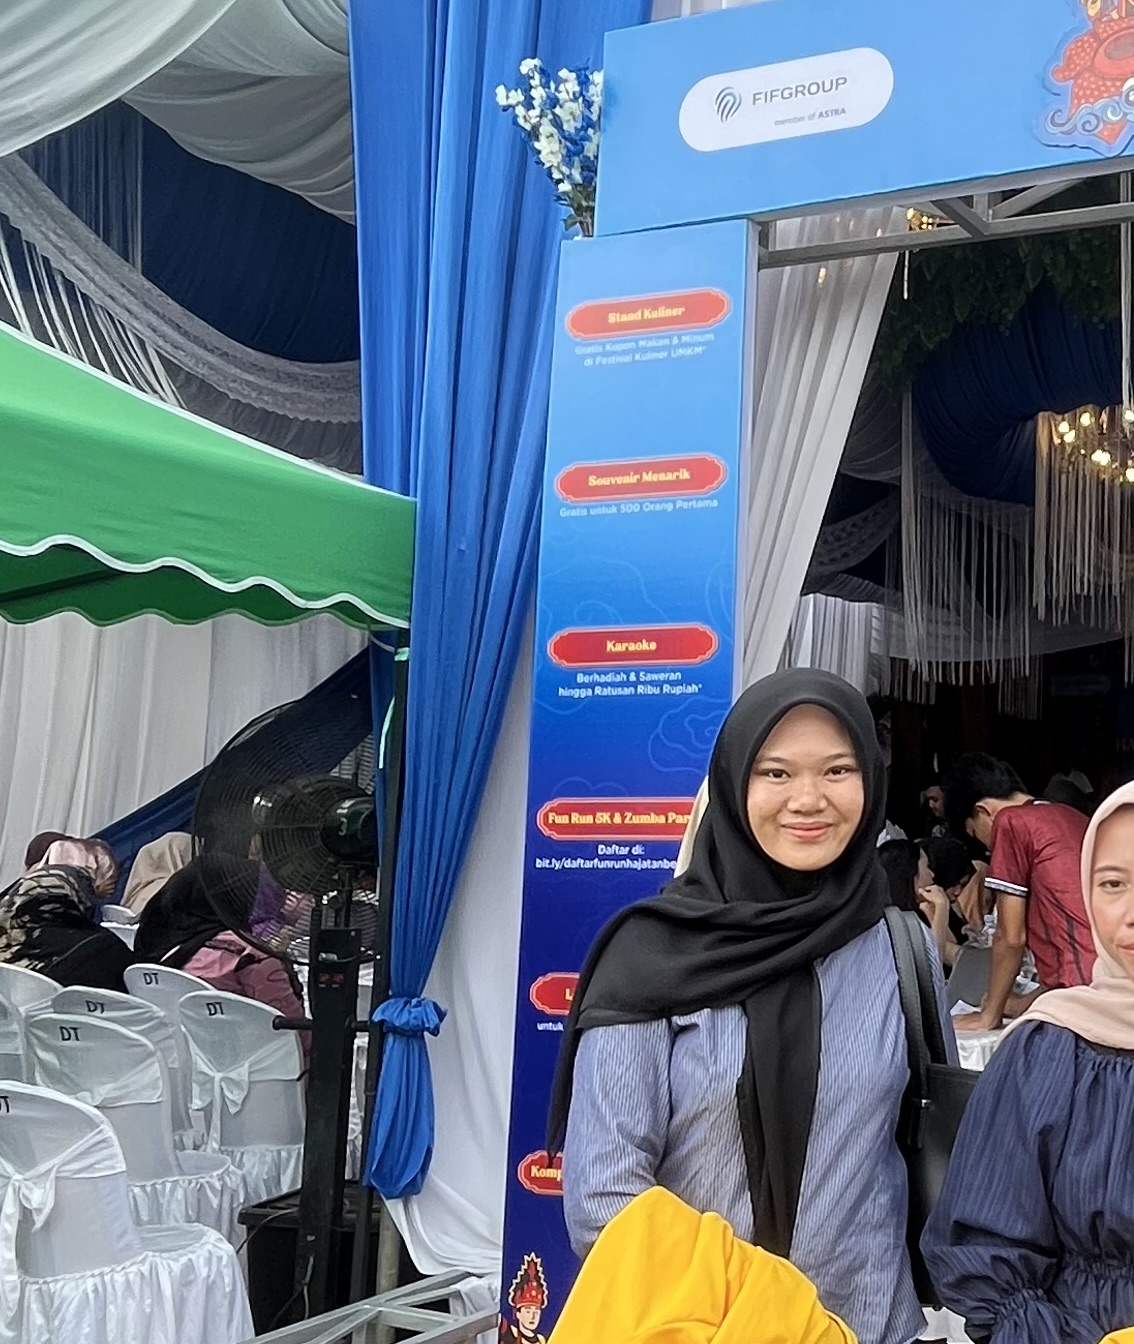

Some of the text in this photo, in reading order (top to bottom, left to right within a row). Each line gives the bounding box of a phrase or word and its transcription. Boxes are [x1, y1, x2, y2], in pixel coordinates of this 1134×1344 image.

[752, 76, 848, 106] FIFGROUP
[818, 107, 846, 120] ASTRA
[608, 306, 686, 324] Stand Kuliner
[575, 343, 603, 355] Gratis
[605, 341, 636, 353] Kupon
[638, 338, 670, 349] Makan
[682, 333, 714, 344] Minum
[583, 356, 594, 367] di
[595, 354, 633, 365] Festival
[635, 351, 668, 362] Kuliner
[588, 468, 690, 487] Souvenir Menarik
[559, 498, 718, 518] Gratis untuk 500 Orang Pertama
[606, 638, 657, 653] Karaoke
[576, 671, 681, 684] Berhadiah & Saweran
[558, 687, 593, 699] hingga
[594, 685, 635, 697] Ratusan
[637, 684, 660, 695] Ribu
[548, 812, 569, 824] Fun
[571, 811, 593, 824] Run
[595, 811, 611, 824] 5K
[613, 812, 622, 824] &
[624, 811, 666, 824] Zumba
[598, 844, 630, 855] Daftar
[143, 972, 159, 986] DT
[85, 1000, 105, 1014] DT
[206, 1001, 225, 1016] DT
[59, 1026, 80, 1042] DT
